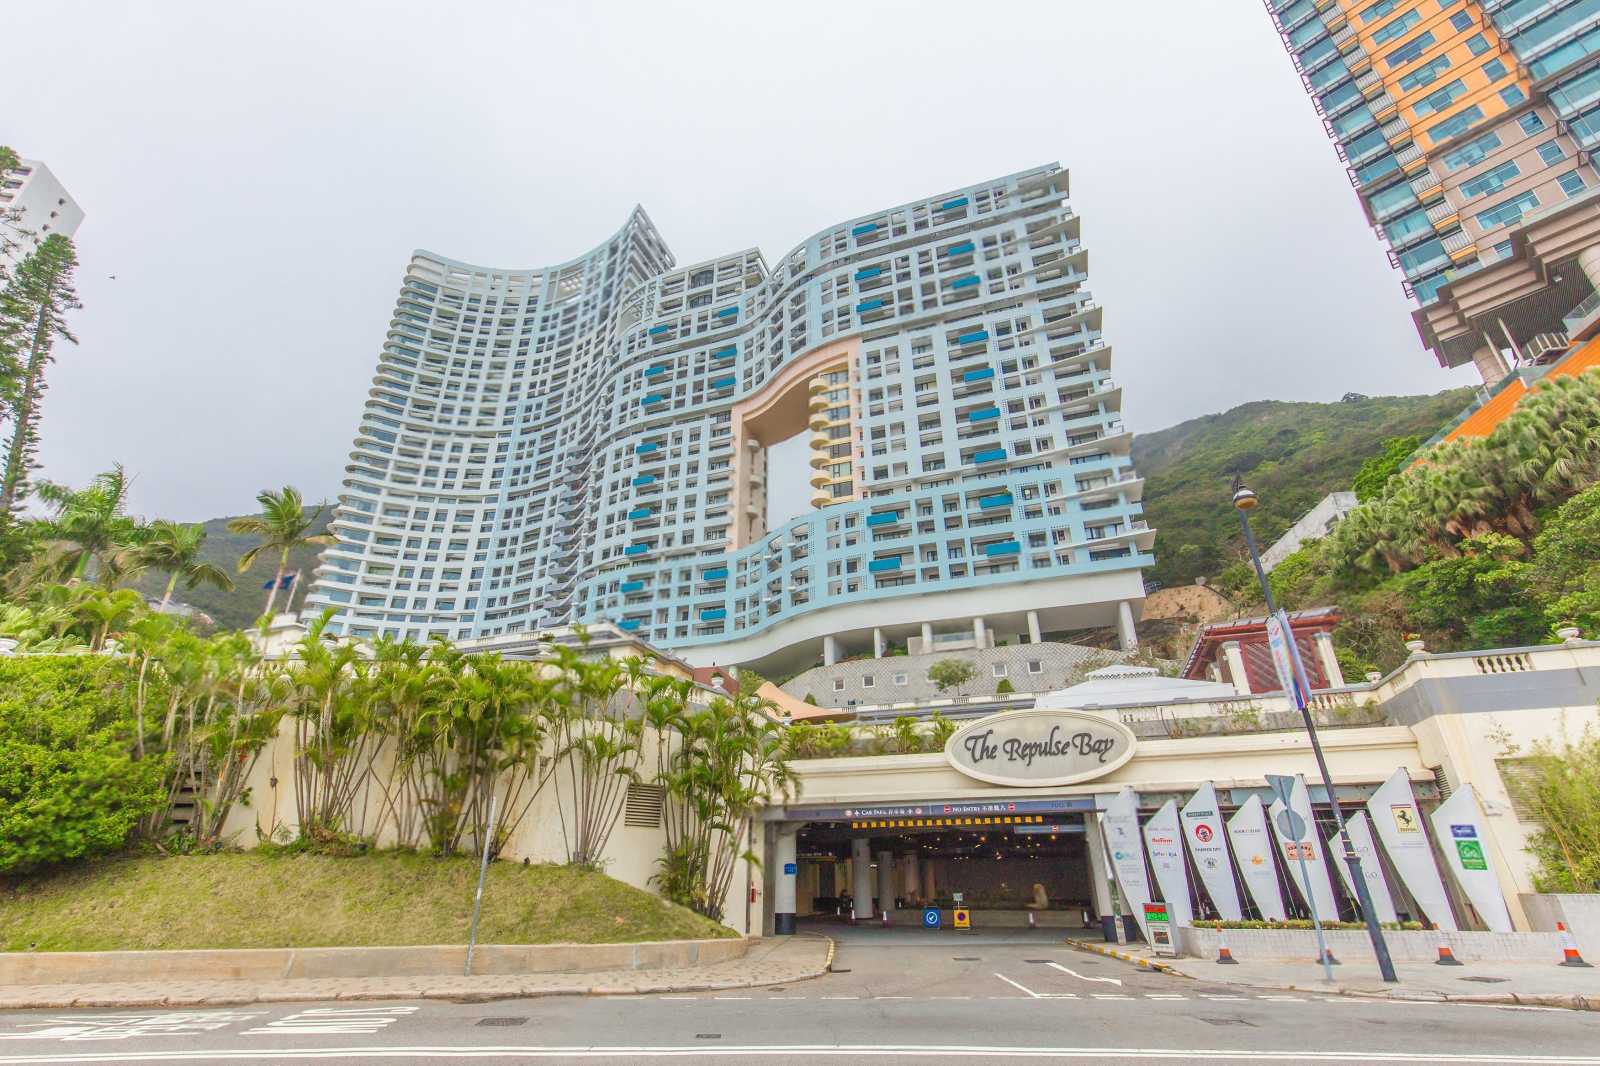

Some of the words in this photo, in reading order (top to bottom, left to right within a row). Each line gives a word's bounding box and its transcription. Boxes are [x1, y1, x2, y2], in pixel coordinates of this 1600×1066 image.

[964, 729, 998, 764] The
[1003, 725, 1071, 766] Repulse
[1071, 732, 1114, 763] Bay
[239, 1006, 420, 1035] SLOW
